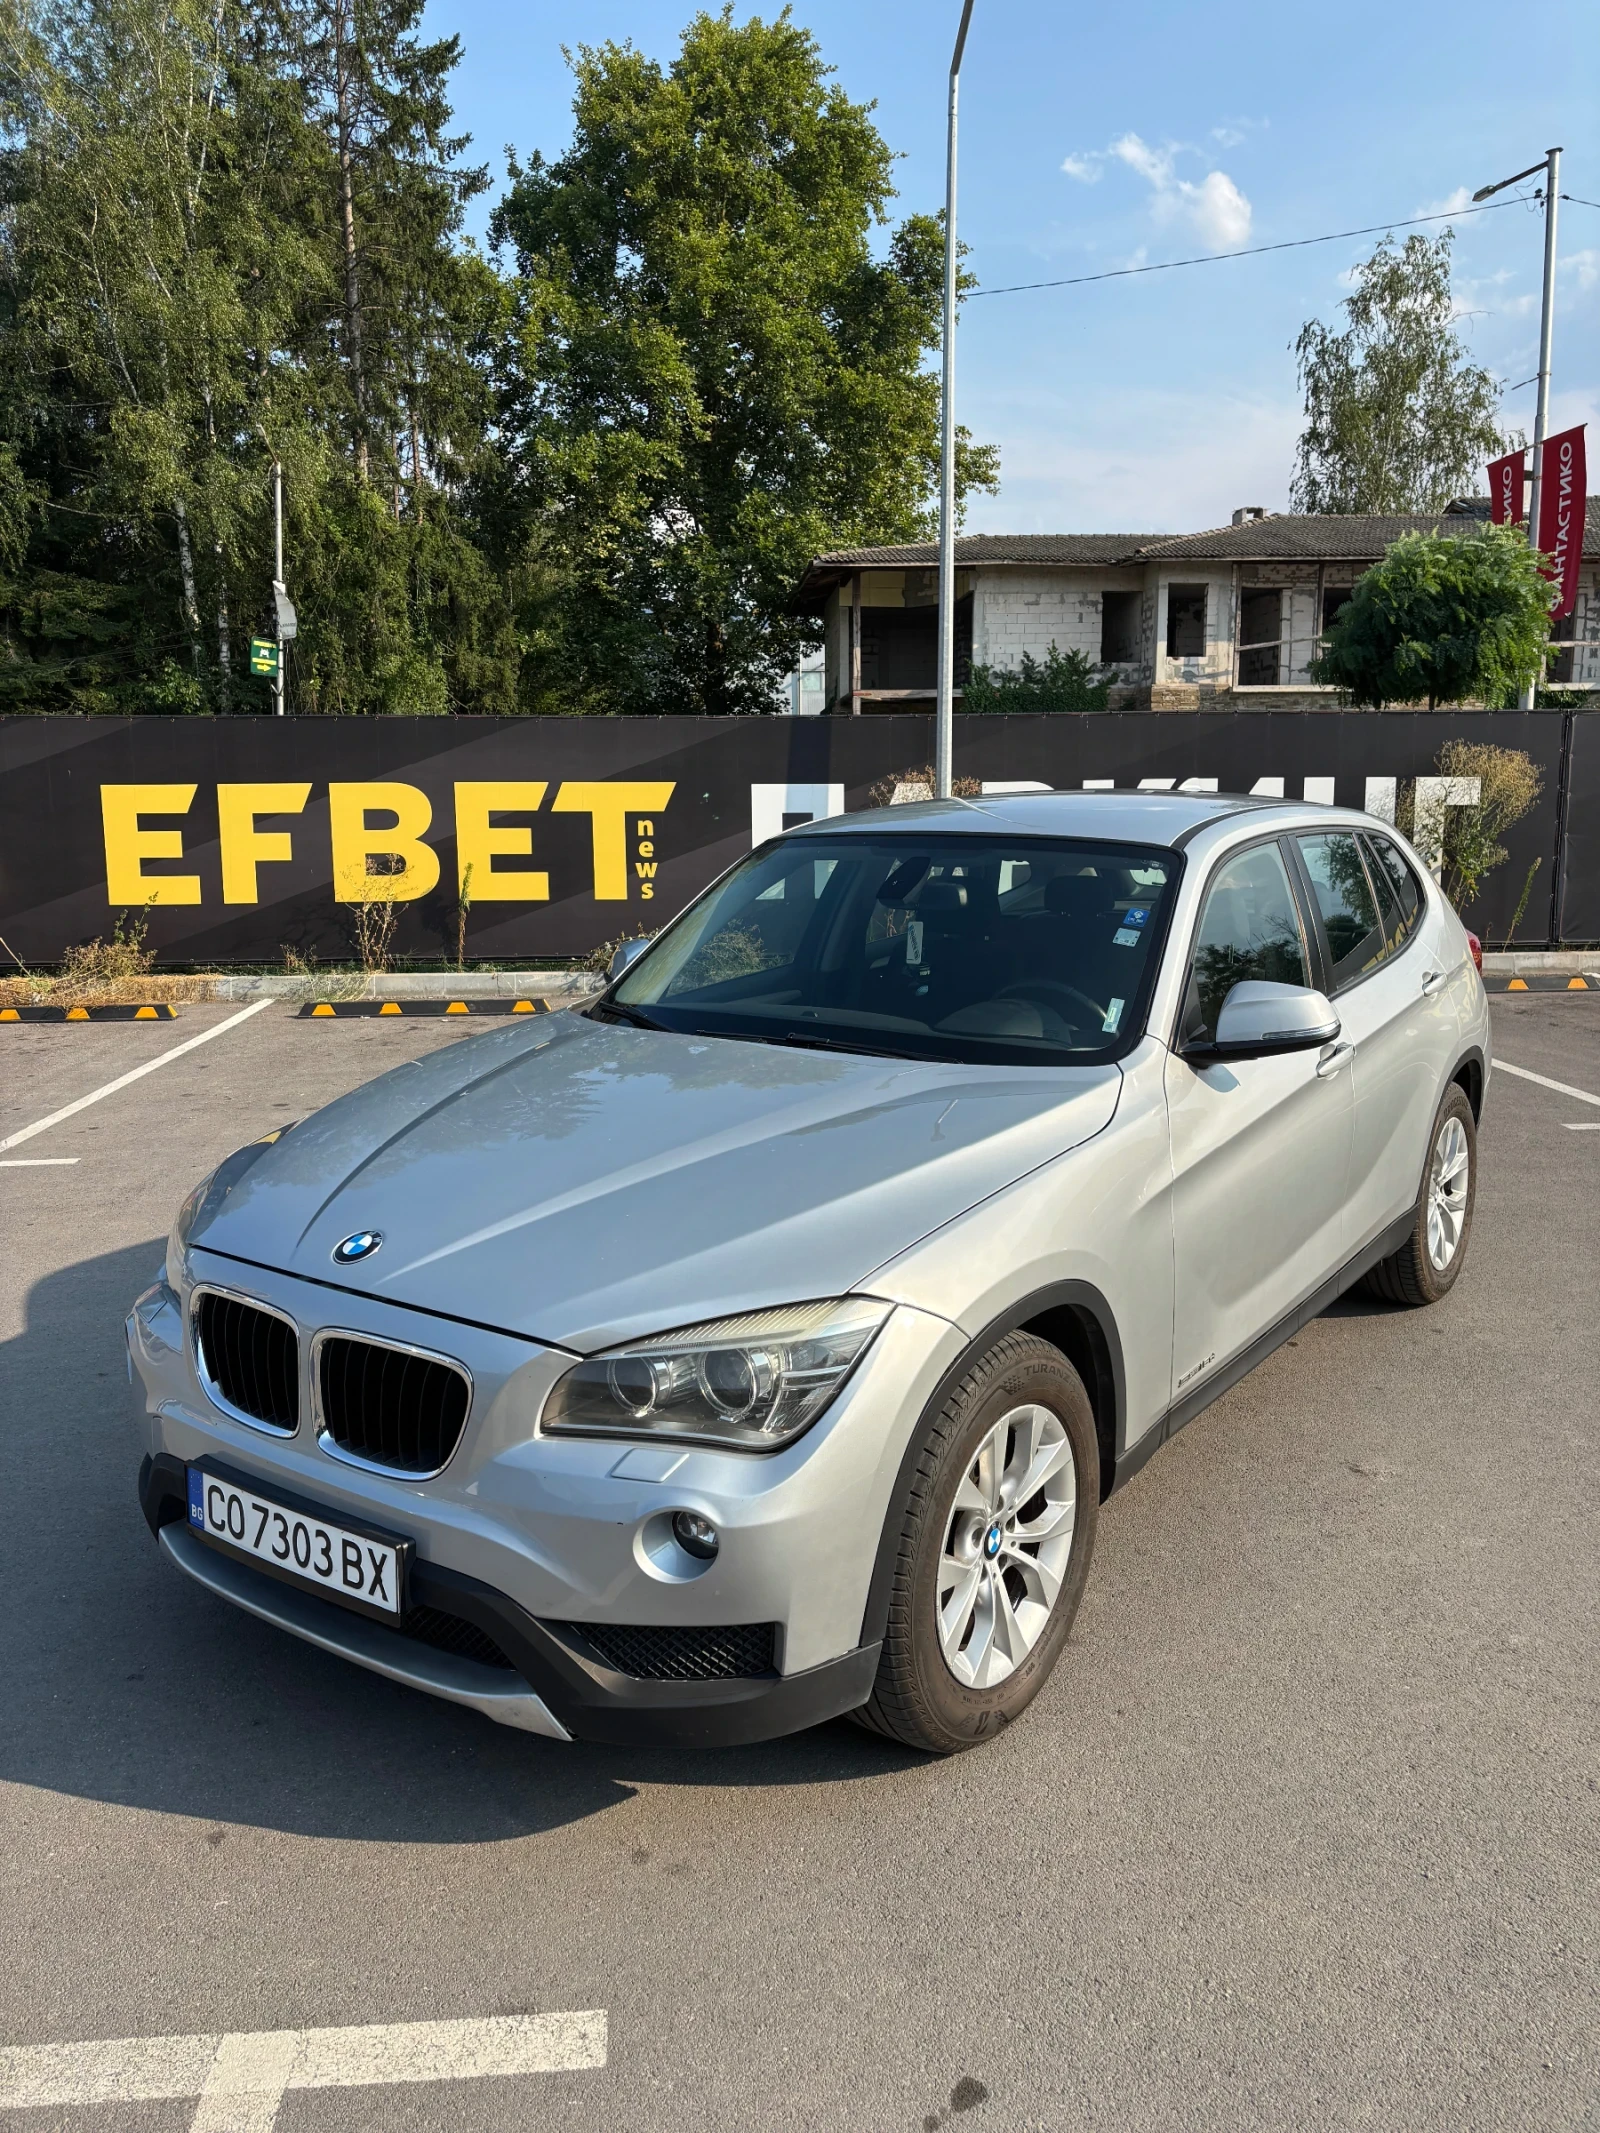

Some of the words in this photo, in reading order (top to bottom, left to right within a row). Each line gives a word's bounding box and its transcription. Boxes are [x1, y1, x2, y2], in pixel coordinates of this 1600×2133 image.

[100, 781, 677, 905] EFBET
[635, 819, 658, 900] news
[191, 1503, 204, 1521] BG
